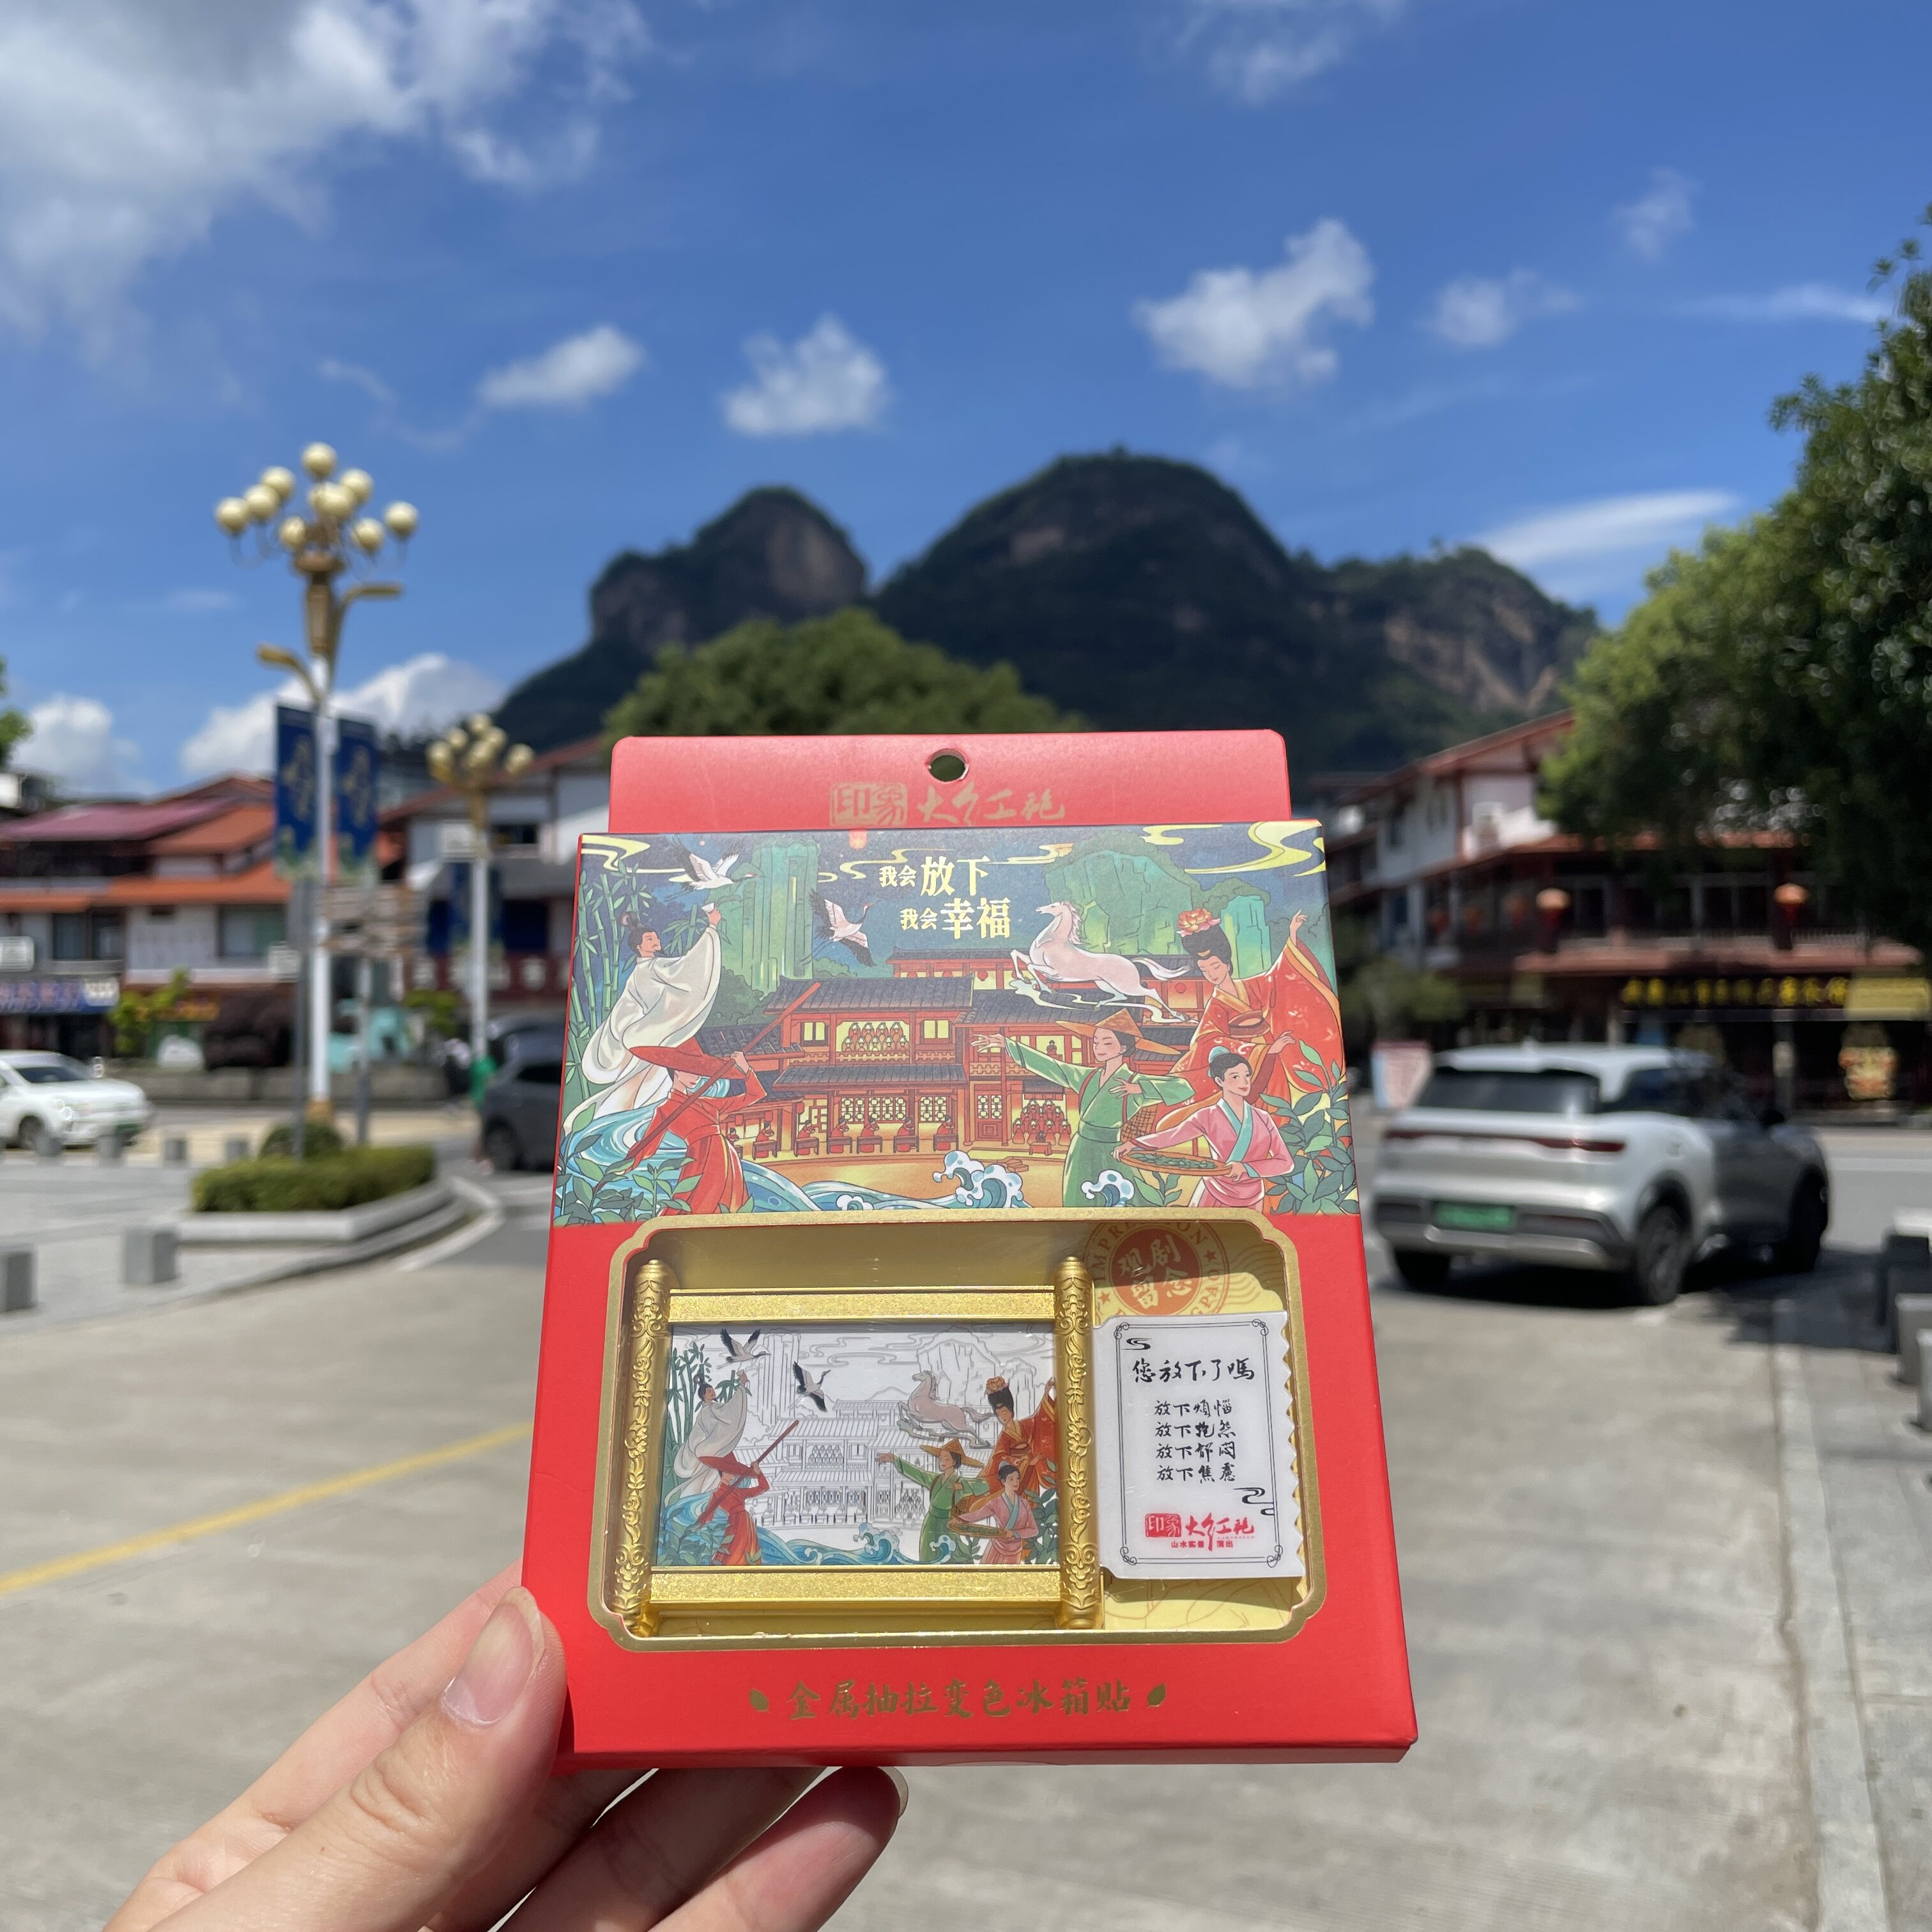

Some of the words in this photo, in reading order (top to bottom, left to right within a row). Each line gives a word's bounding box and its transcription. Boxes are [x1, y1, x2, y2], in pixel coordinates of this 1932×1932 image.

[878, 855, 990, 897] 我会放下
[900, 897, 1011, 939] 我会幸福
[1091, 1222, 1208, 1280] IMPRON
[1132, 1358, 1255, 1383] 您放下了嗎
[1155, 1419, 1236, 1438] 放下抱怨
[786, 1676, 1130, 1720] 金属抽拉变色冰箱贴
